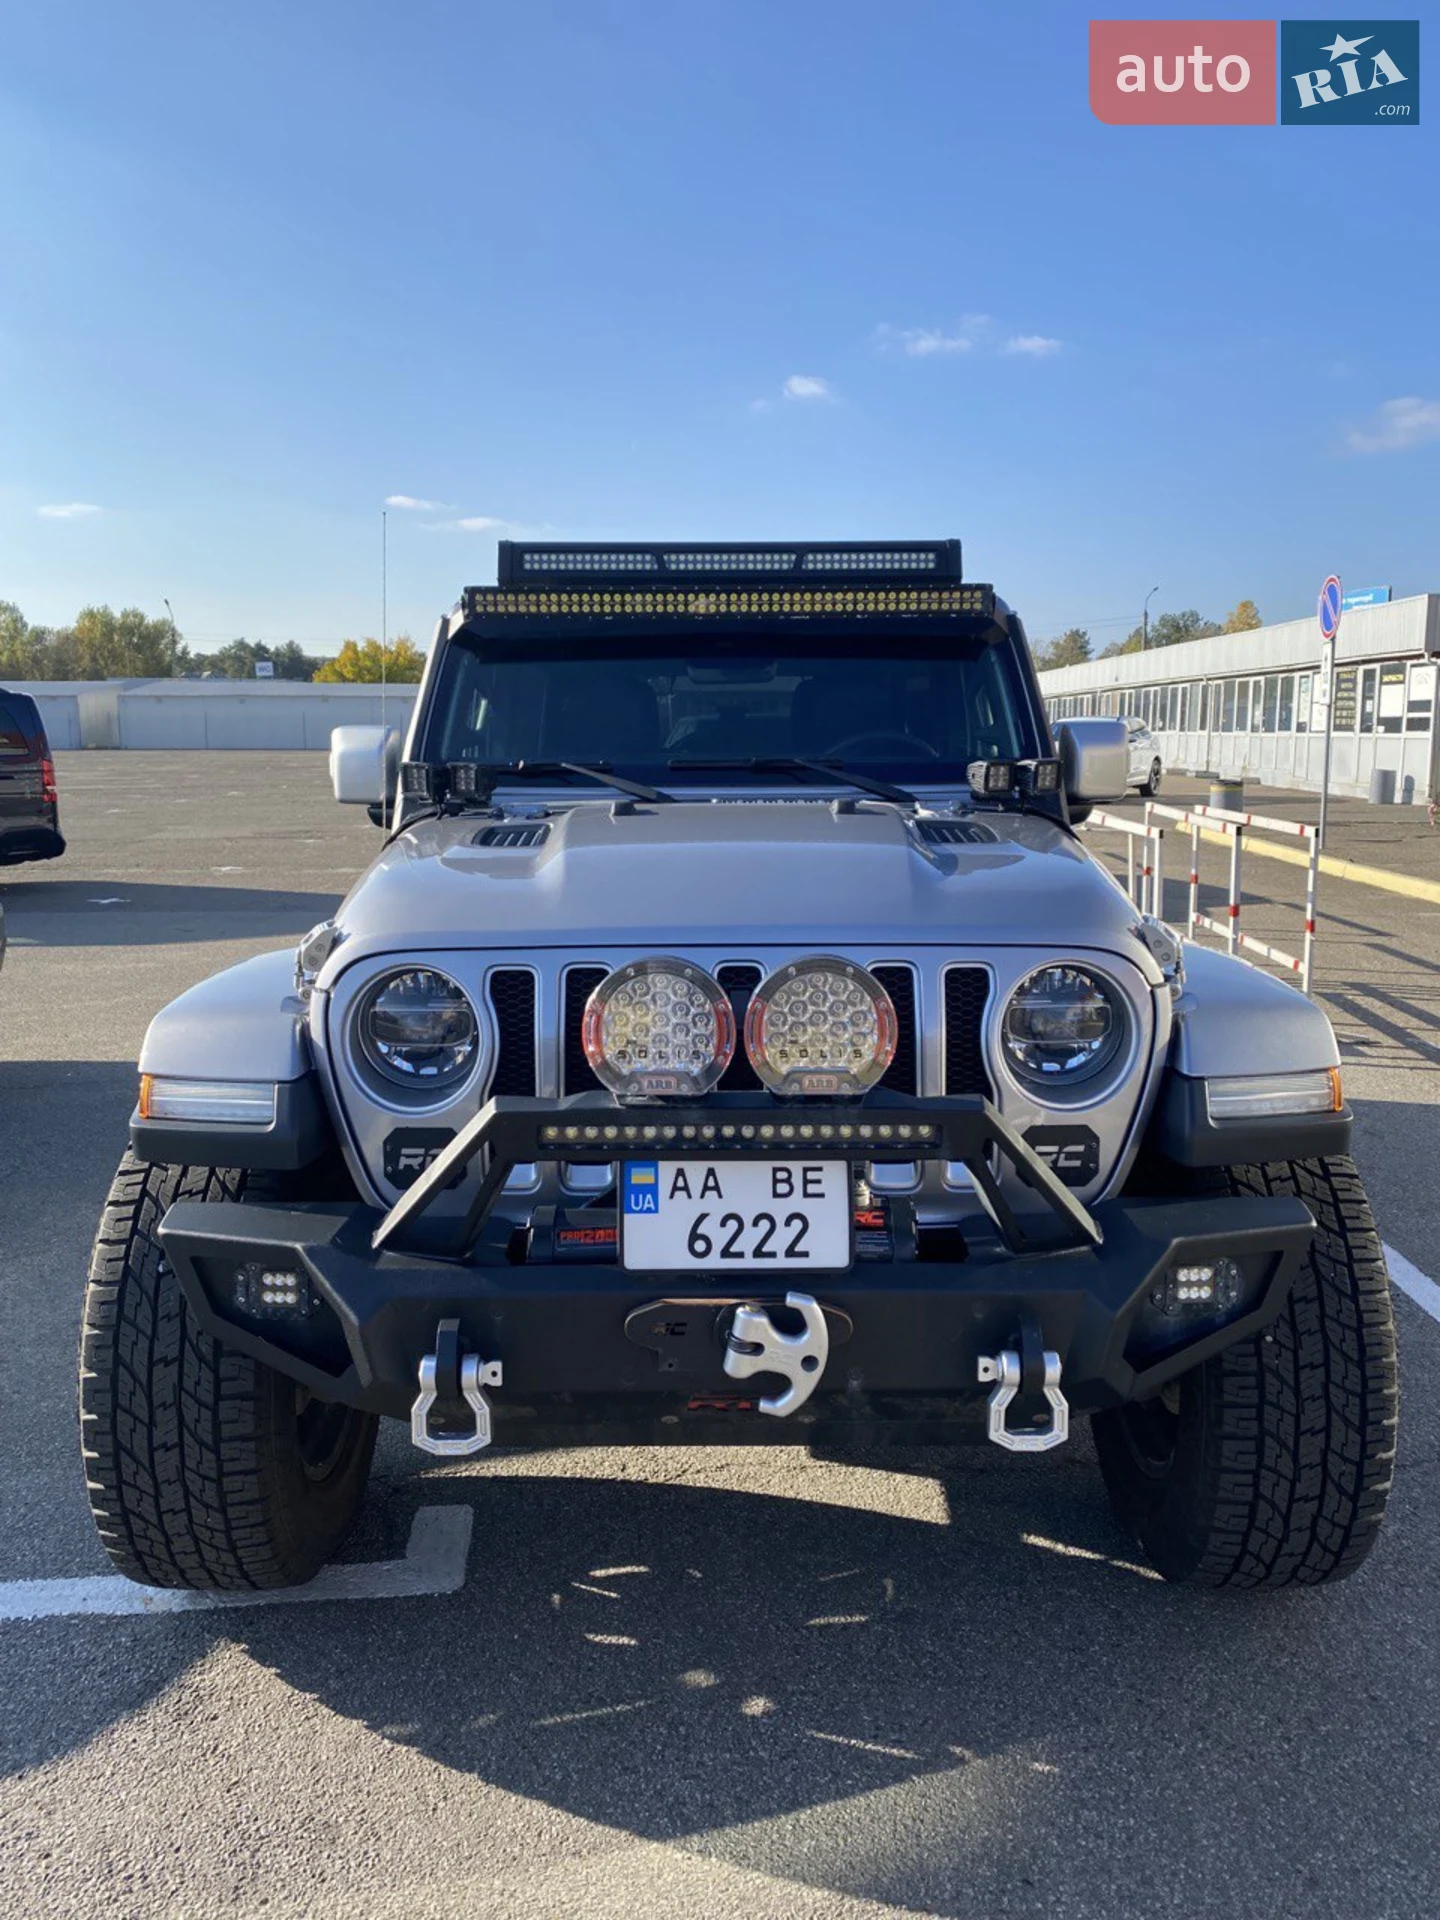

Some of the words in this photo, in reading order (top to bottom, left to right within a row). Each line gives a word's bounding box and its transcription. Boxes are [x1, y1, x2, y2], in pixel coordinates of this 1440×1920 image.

[780, 1048, 862, 1059] SOLIS
[668, 1167, 724, 1200] AA
[771, 1166, 826, 1199] BE
[630, 1193, 656, 1212] UA
[687, 1211, 811, 1260] 6222
